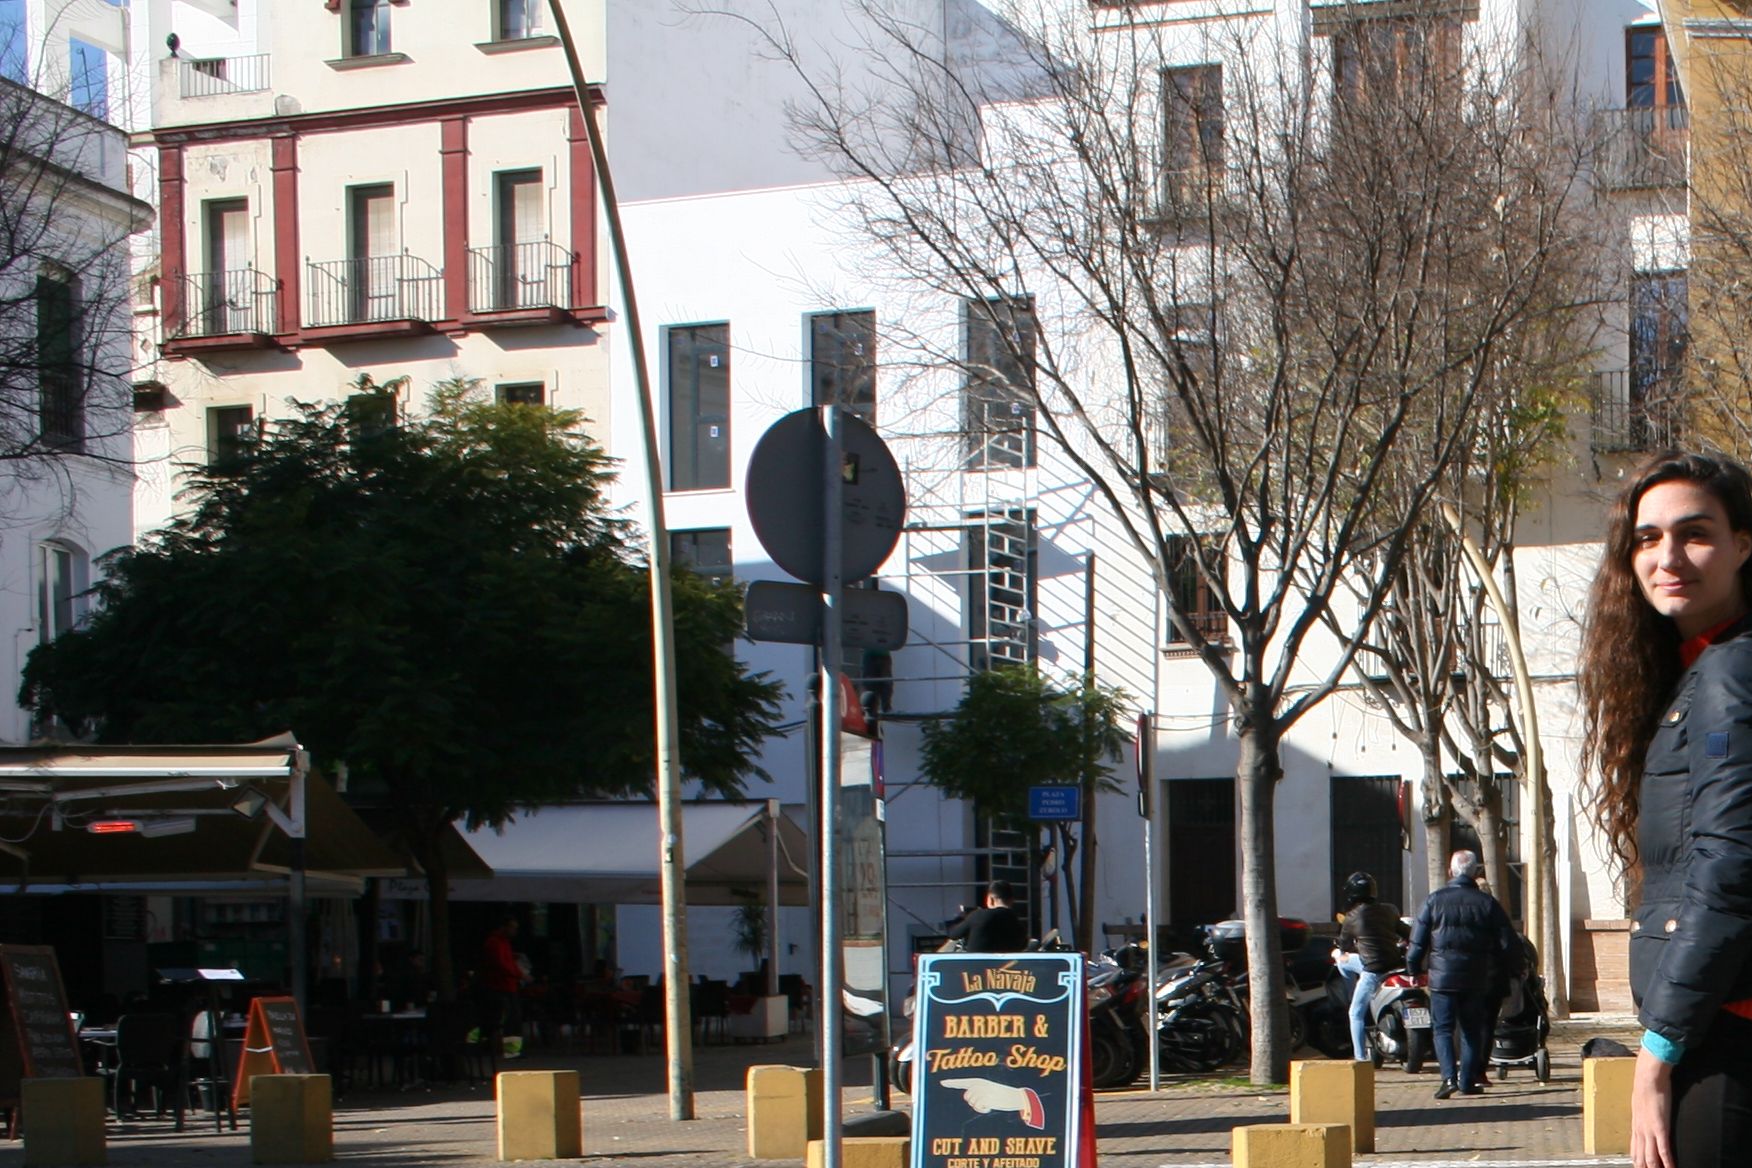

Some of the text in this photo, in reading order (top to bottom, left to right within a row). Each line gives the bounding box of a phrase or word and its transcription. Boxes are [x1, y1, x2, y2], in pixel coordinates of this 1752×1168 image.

[961, 966, 1037, 993] La Navaja
[944, 1013, 1049, 1038] BARBER &
[926, 1044, 1067, 1078] Tattoo Shop
[932, 1137, 1057, 1156] CUT AND SHAVE
[947, 1157, 1040, 1168] CORTE Y AFEITADO
